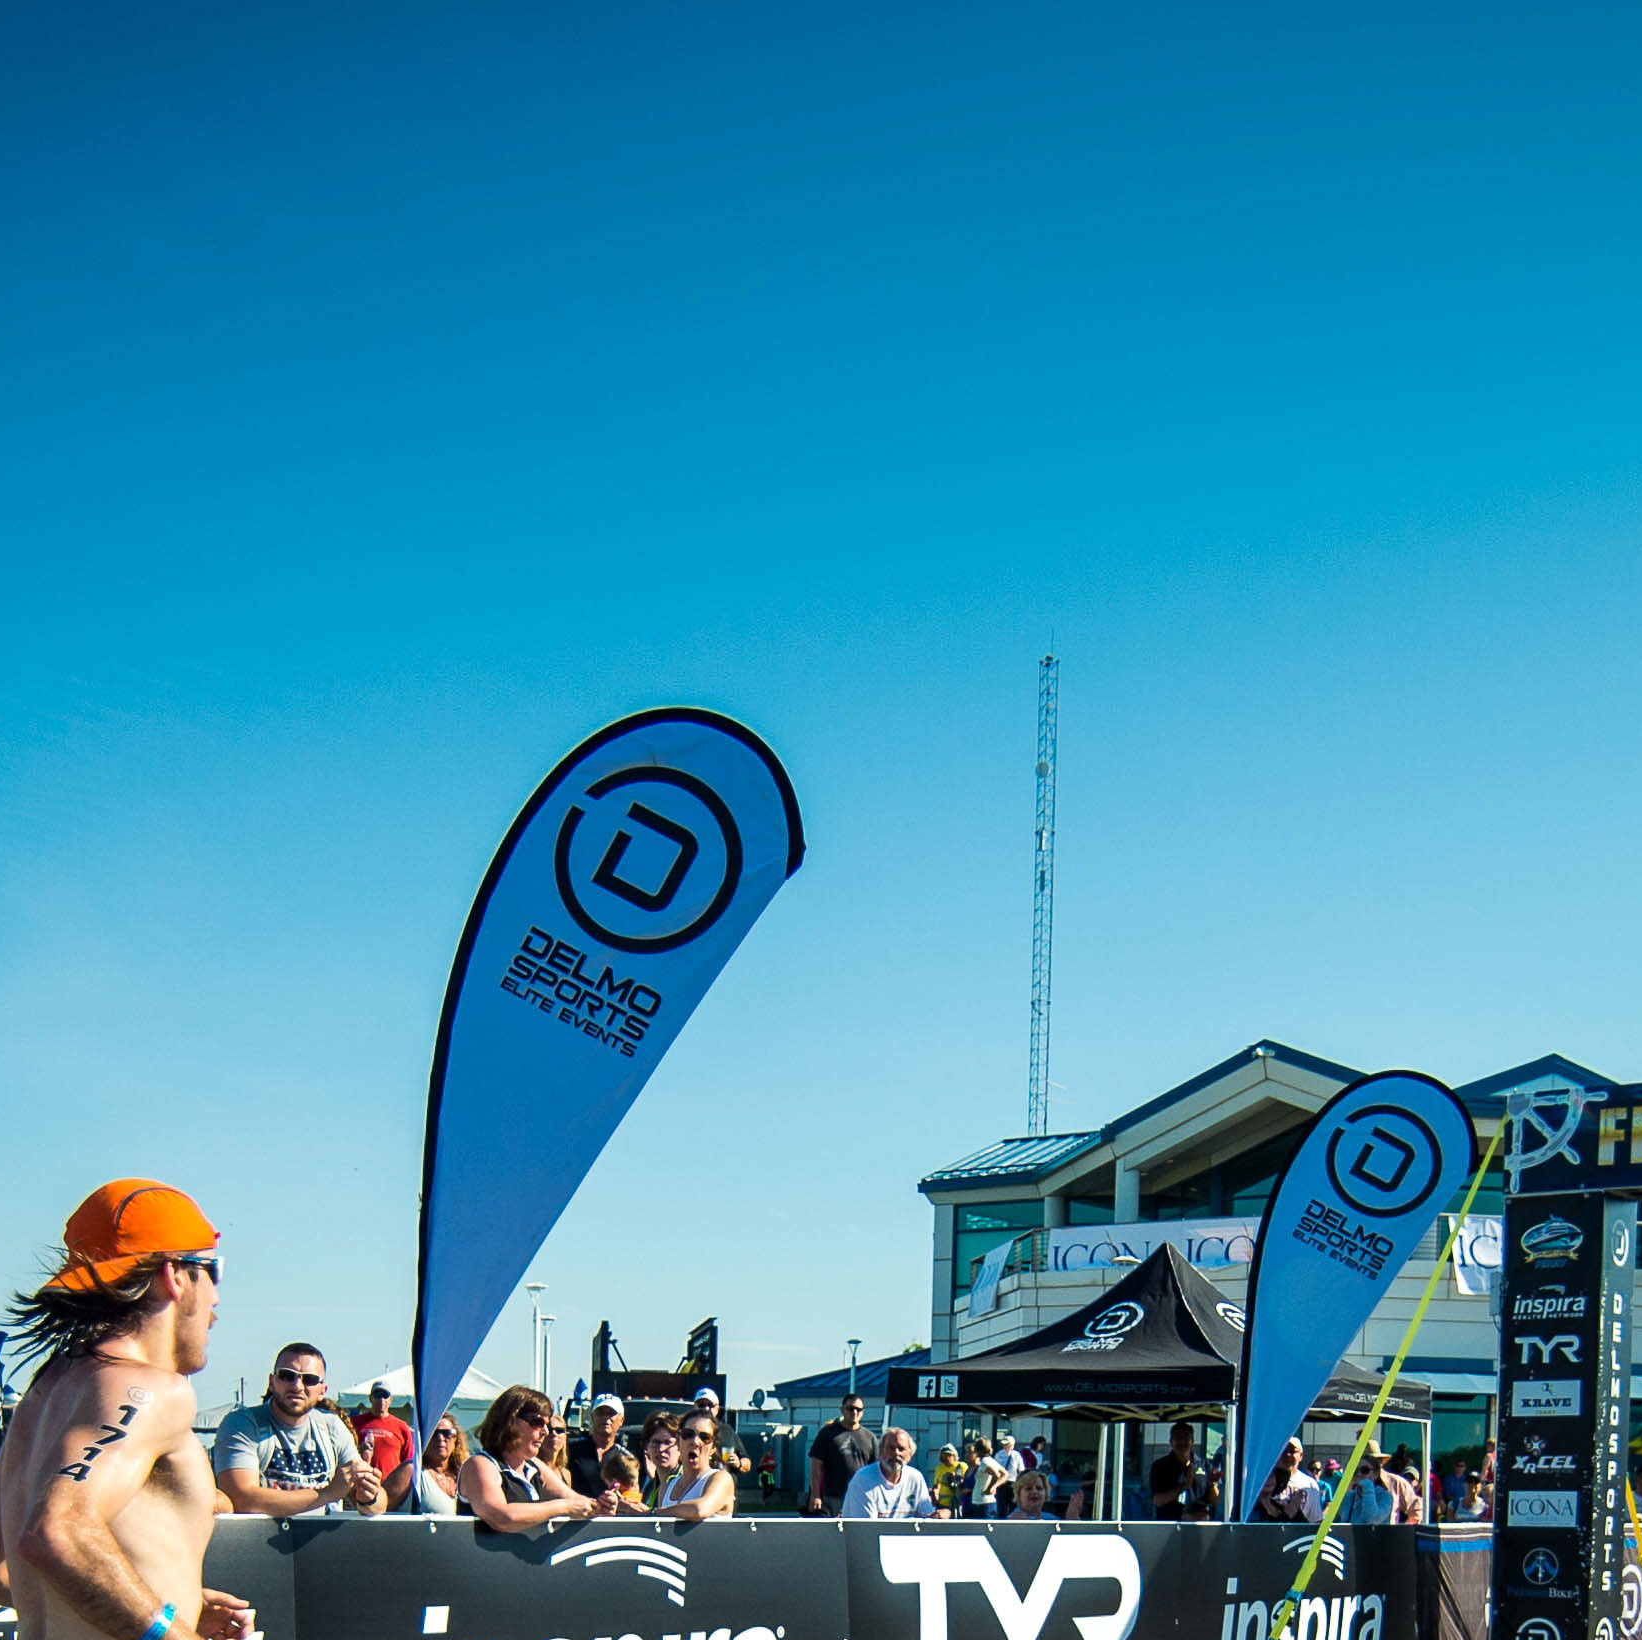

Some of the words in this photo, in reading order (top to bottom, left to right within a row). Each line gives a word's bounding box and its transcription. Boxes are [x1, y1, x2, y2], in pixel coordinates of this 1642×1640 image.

[520, 926, 662, 1019] DELMO
[500, 974, 554, 1013] ELITE
[558, 1007, 638, 1059] EVENTS
[508, 954, 651, 1042] SPORTS
[1297, 1215, 1386, 1272] SPORTS
[1305, 1199, 1394, 1257] DELMO
[1053, 1240, 1150, 1271] ICON
[1186, 1235, 1255, 1264] ICO
[1293, 1229, 1328, 1254] ELITE
[1329, 1249, 1379, 1281] EVENTS
[1513, 1295, 1585, 1318] inspira
[1514, 1335, 1581, 1364] TYR
[1520, 1398, 1572, 1408] KRAVE
[1510, 1497, 1574, 1516] ICONA
